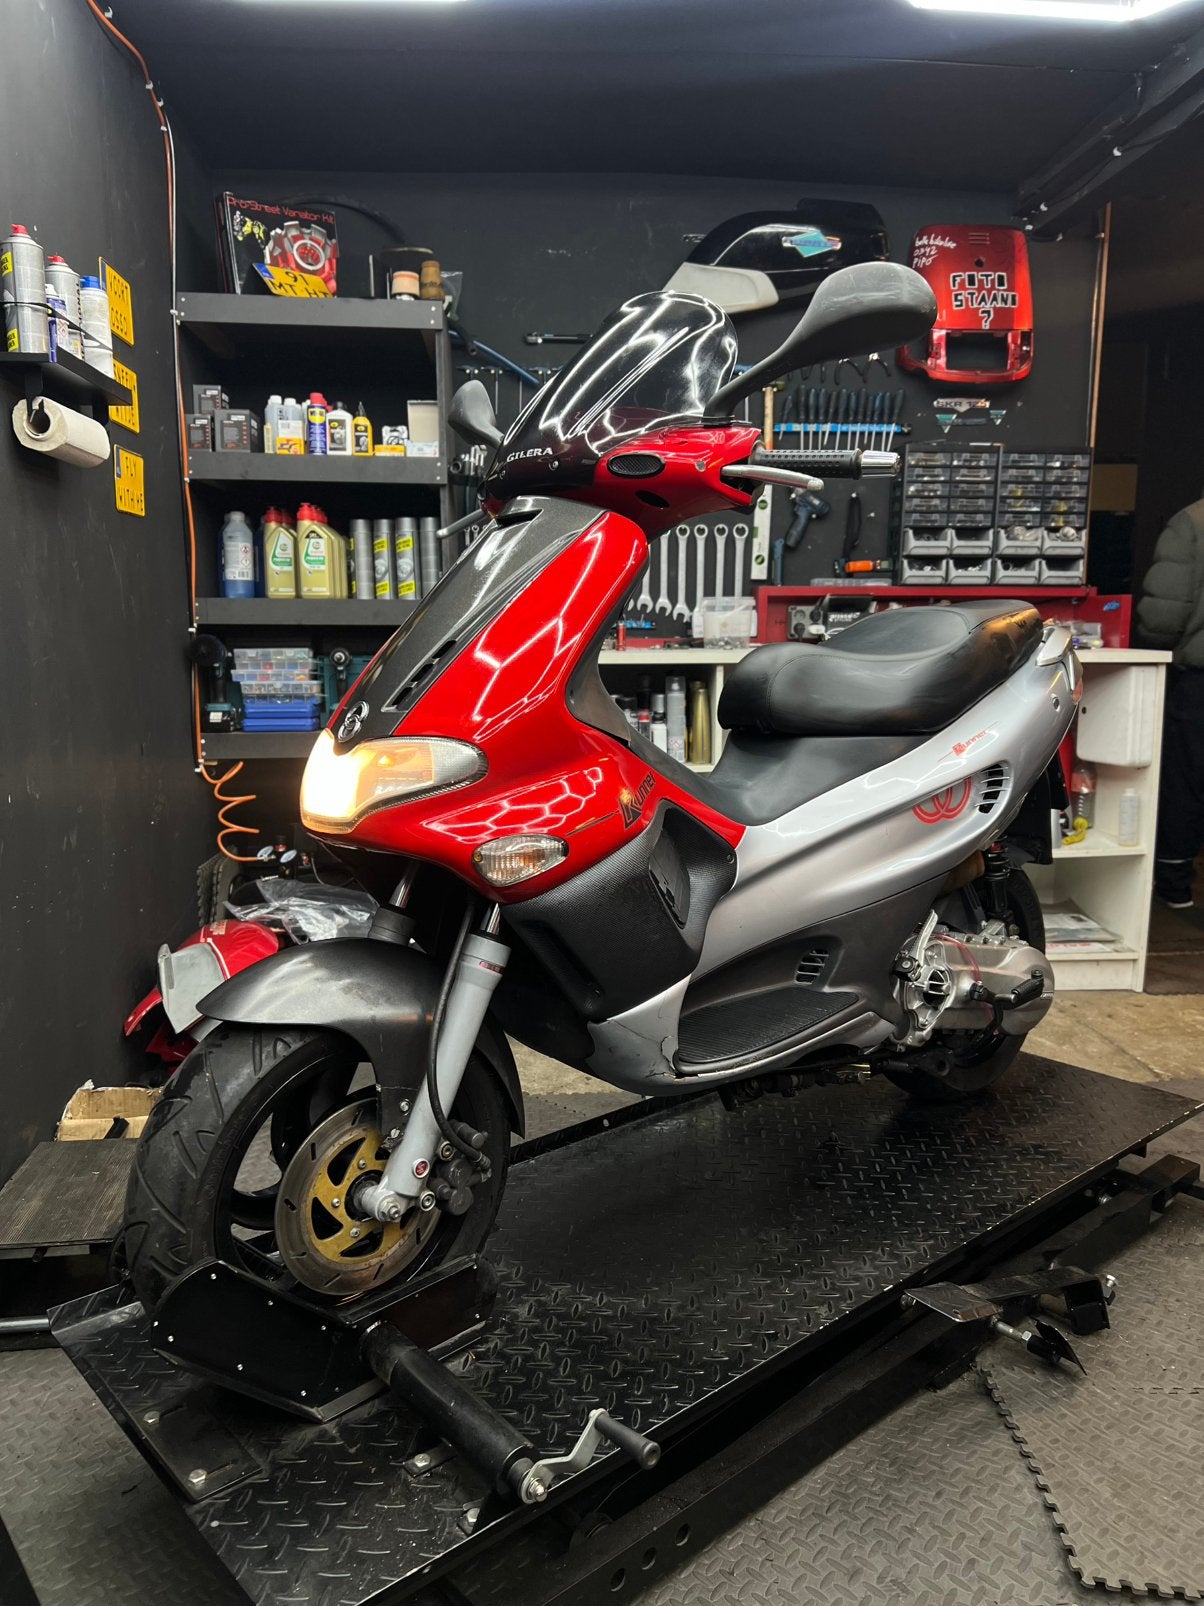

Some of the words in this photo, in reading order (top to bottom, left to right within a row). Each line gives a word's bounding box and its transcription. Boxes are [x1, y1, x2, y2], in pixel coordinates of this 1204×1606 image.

[285, 271, 309, 287] 91
[506, 447, 553, 462] GILERA
[125, 455, 136, 477] FLY
[952, 731, 986, 757] Runner
[619, 769, 656, 832] Runner
